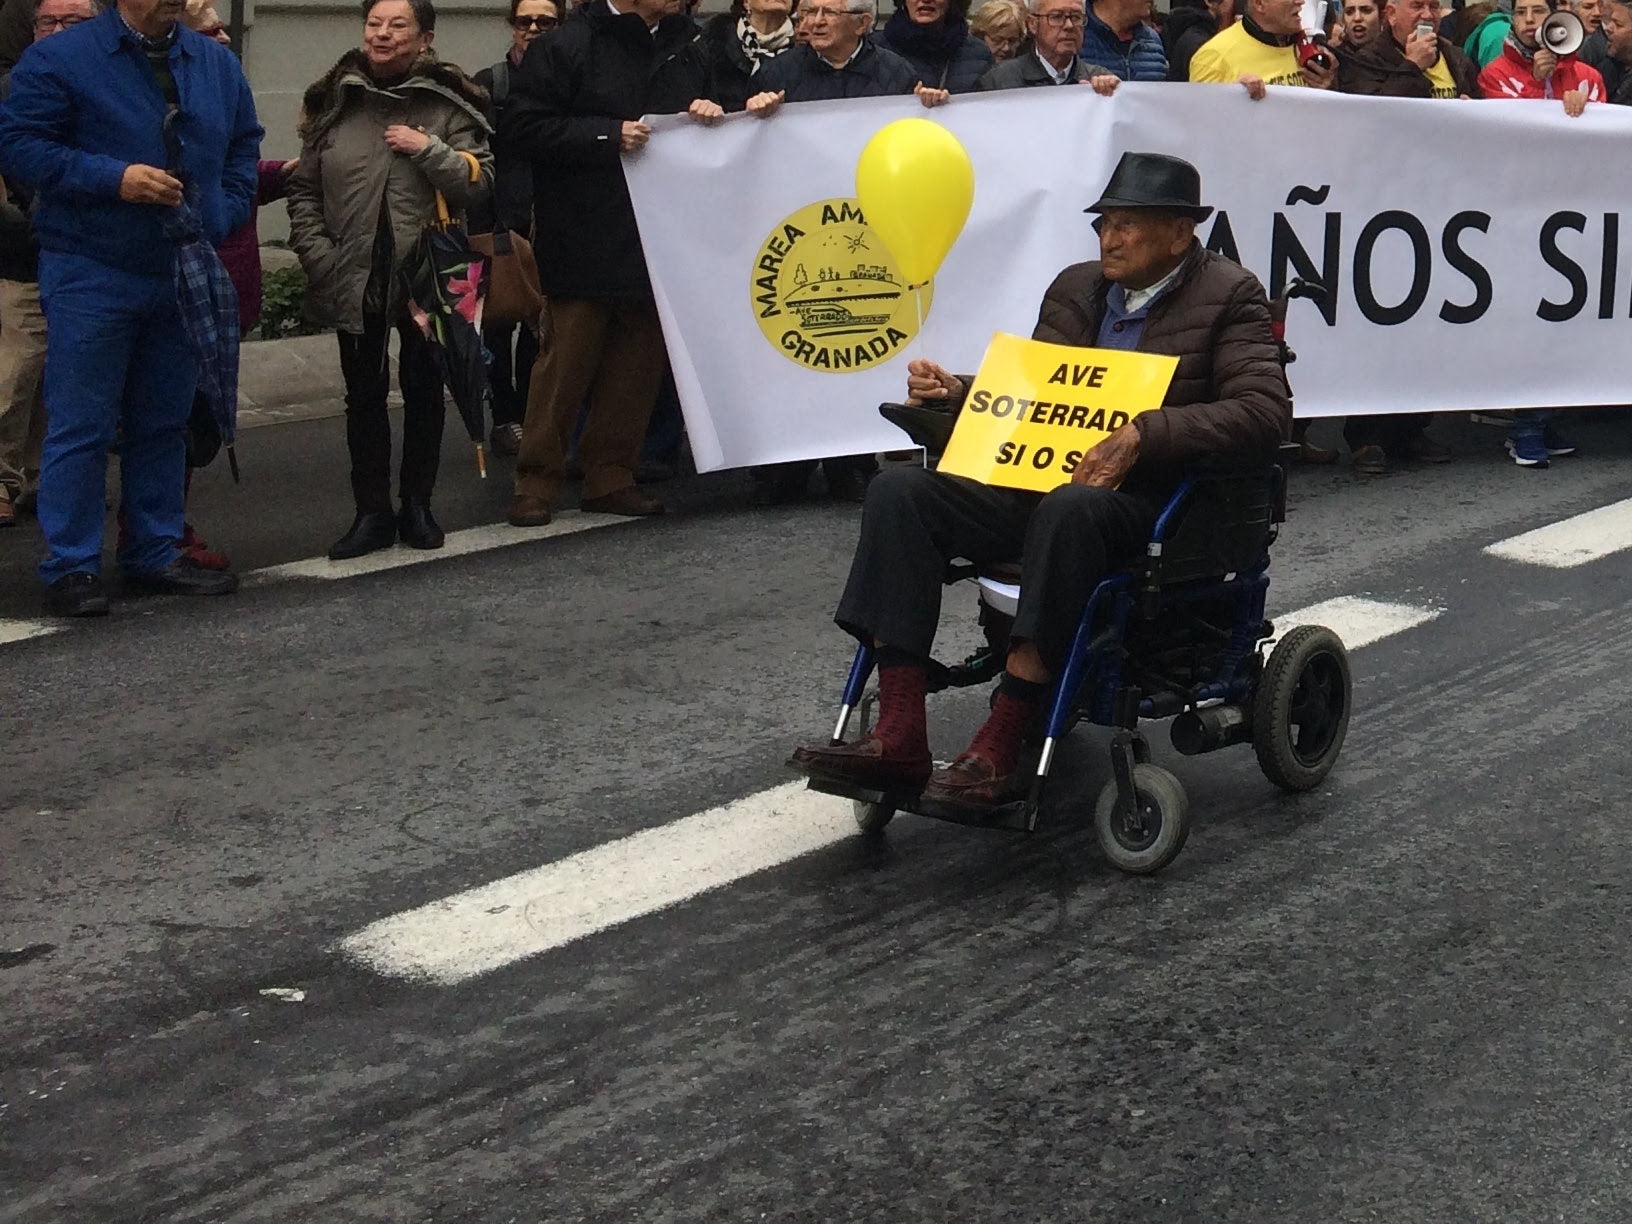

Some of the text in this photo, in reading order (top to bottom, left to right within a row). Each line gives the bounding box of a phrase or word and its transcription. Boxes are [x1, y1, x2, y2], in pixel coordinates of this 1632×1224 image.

[756, 223, 806, 319] MAREA
[781, 326, 908, 369] GRANADA
[1048, 363, 1108, 389] AVE
[969, 390, 1133, 433] SOTERRAD
[995, 441, 1084, 474] SI O S
